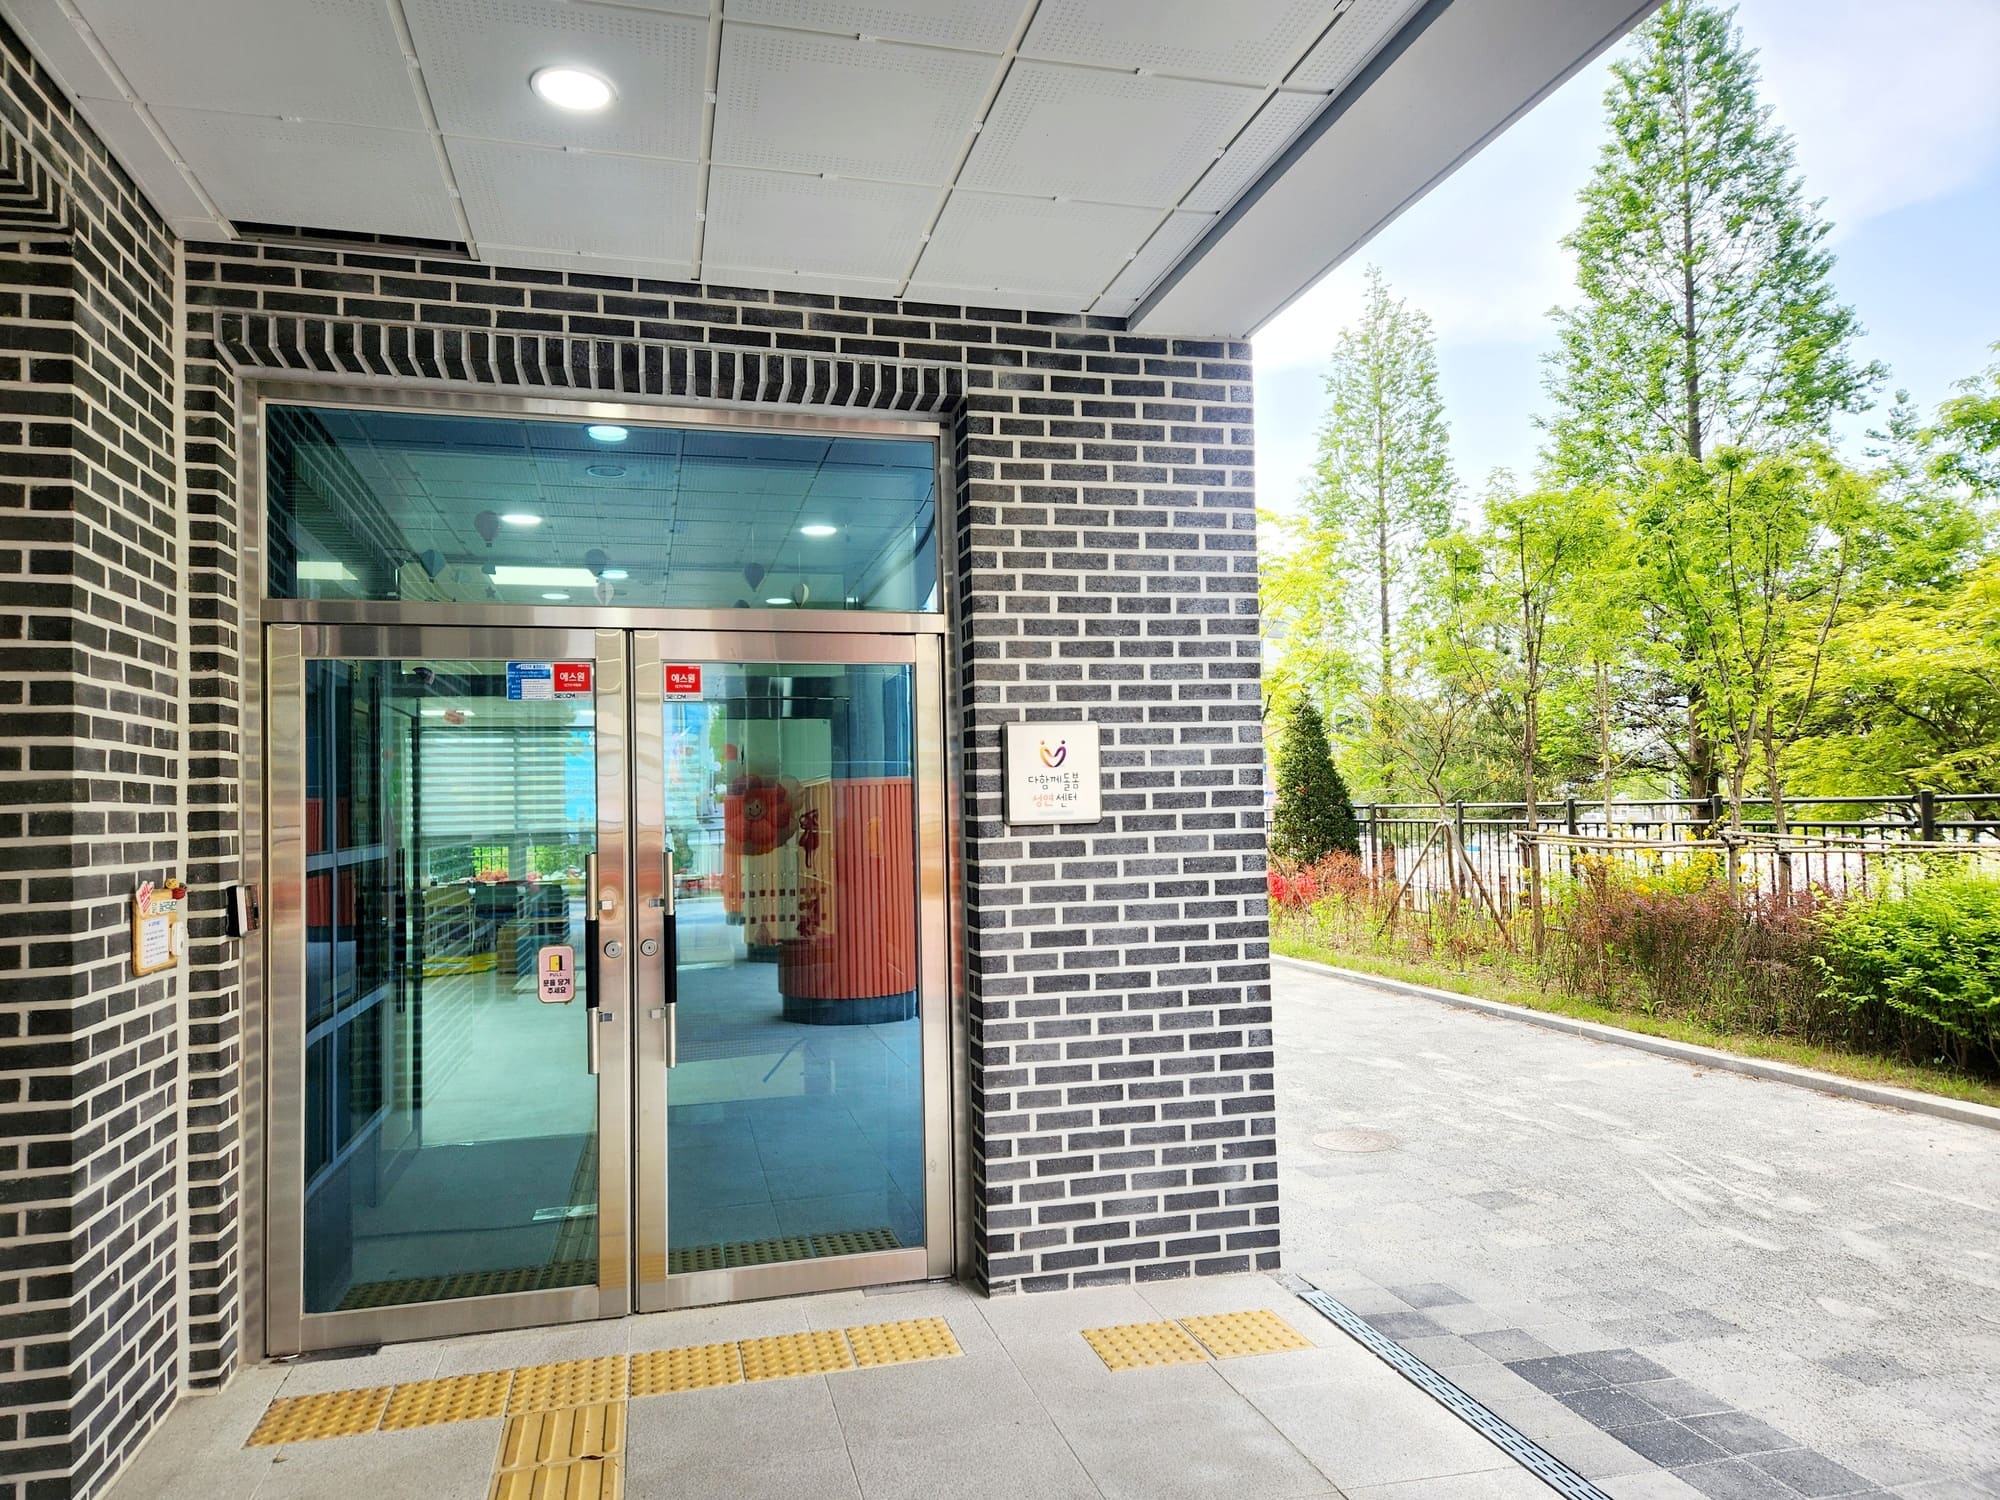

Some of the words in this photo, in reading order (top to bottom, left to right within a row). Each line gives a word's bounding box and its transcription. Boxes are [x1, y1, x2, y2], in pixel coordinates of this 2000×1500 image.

[559, 671, 585, 682] 에스원
[670, 673, 696, 683] 에스원
[1027, 772, 1080, 791] 다함께돌봄
[1055, 792, 1077, 808] 센터
